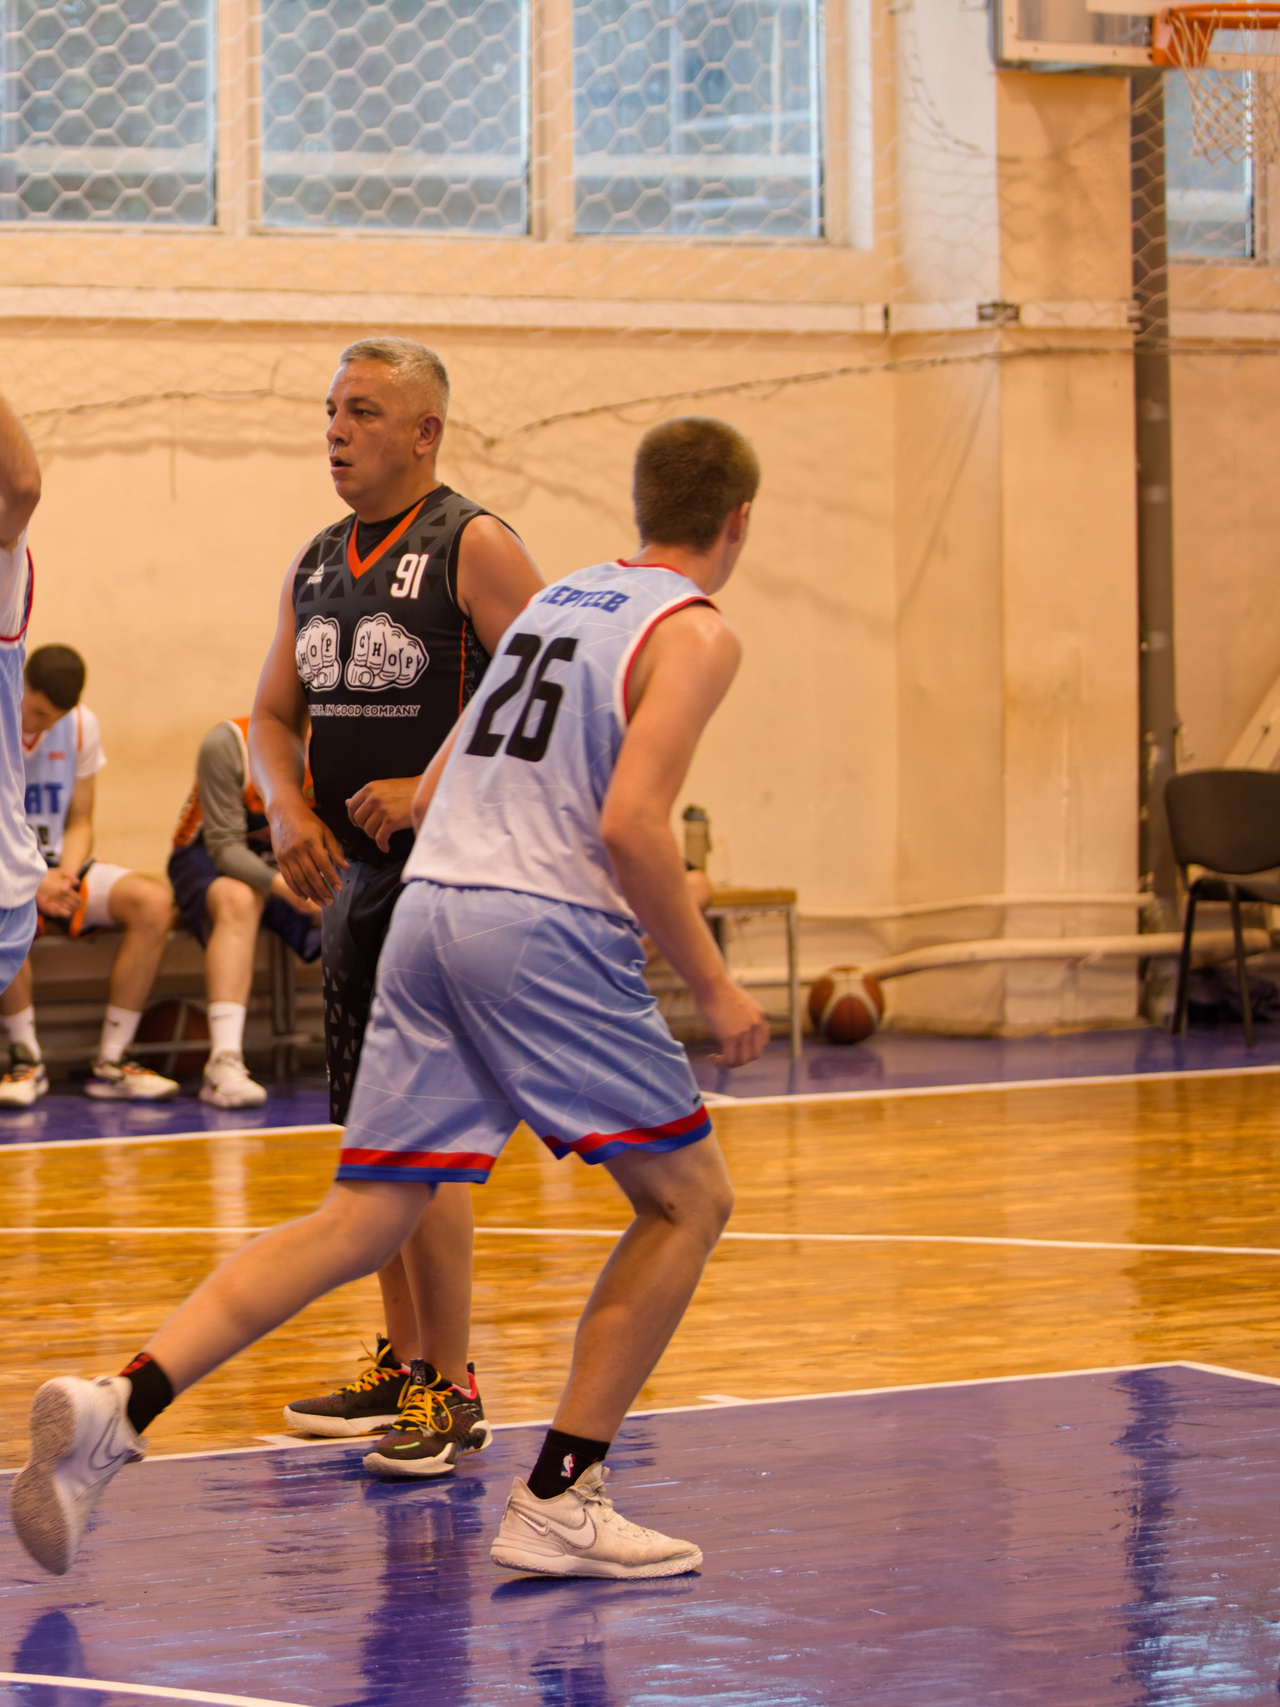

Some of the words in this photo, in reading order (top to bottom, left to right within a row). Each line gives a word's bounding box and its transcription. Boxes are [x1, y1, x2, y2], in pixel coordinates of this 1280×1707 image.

[390, 553, 429, 599] 91
[359, 635, 414, 669] CHOP
[334, 704, 363, 716] GOOD
[363, 704, 421, 717] COMPANY
[464, 632, 579, 763] 26
